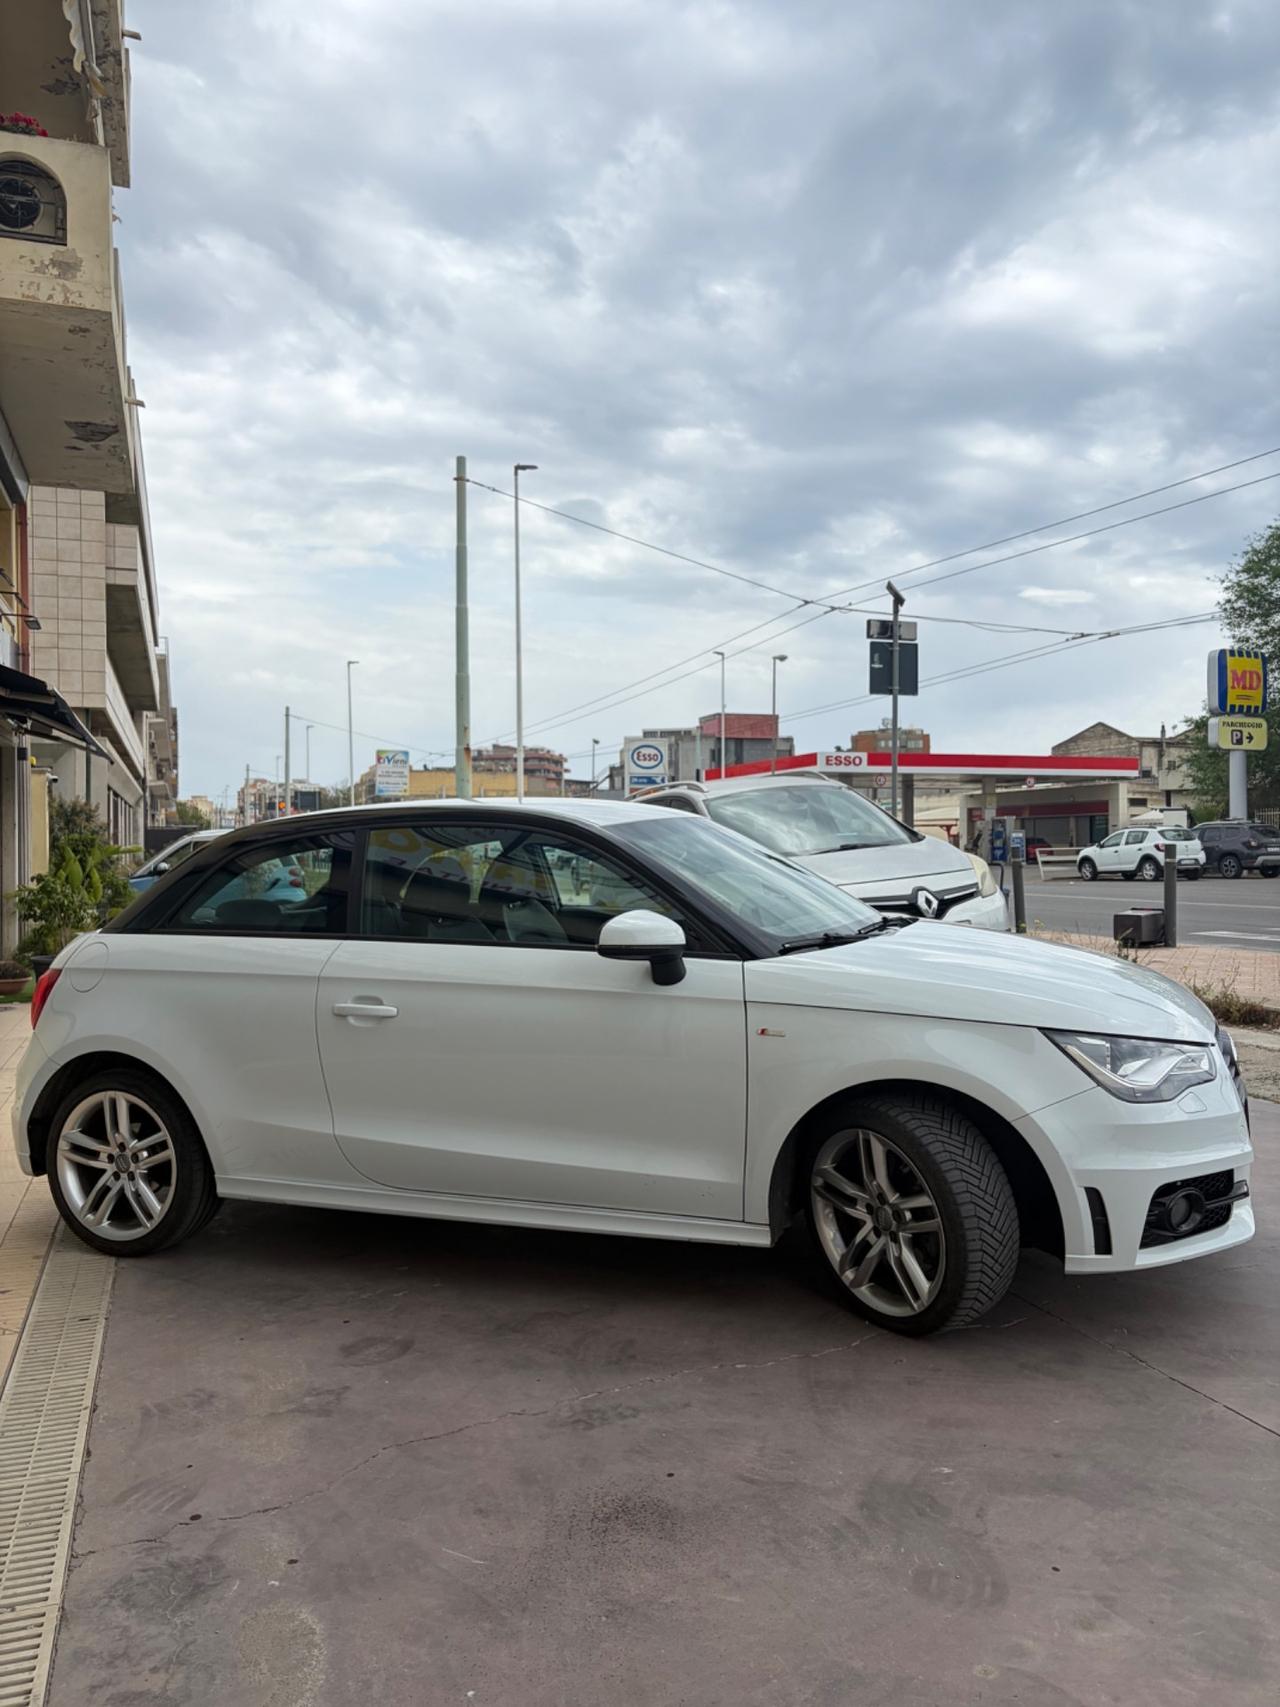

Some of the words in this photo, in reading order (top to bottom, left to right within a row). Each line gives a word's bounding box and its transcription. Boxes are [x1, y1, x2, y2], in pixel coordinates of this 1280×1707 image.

[1230, 669, 1262, 690] MD
[1222, 721, 1263, 729] PARCHEGGIO
[825, 755, 863, 767] ESSO
